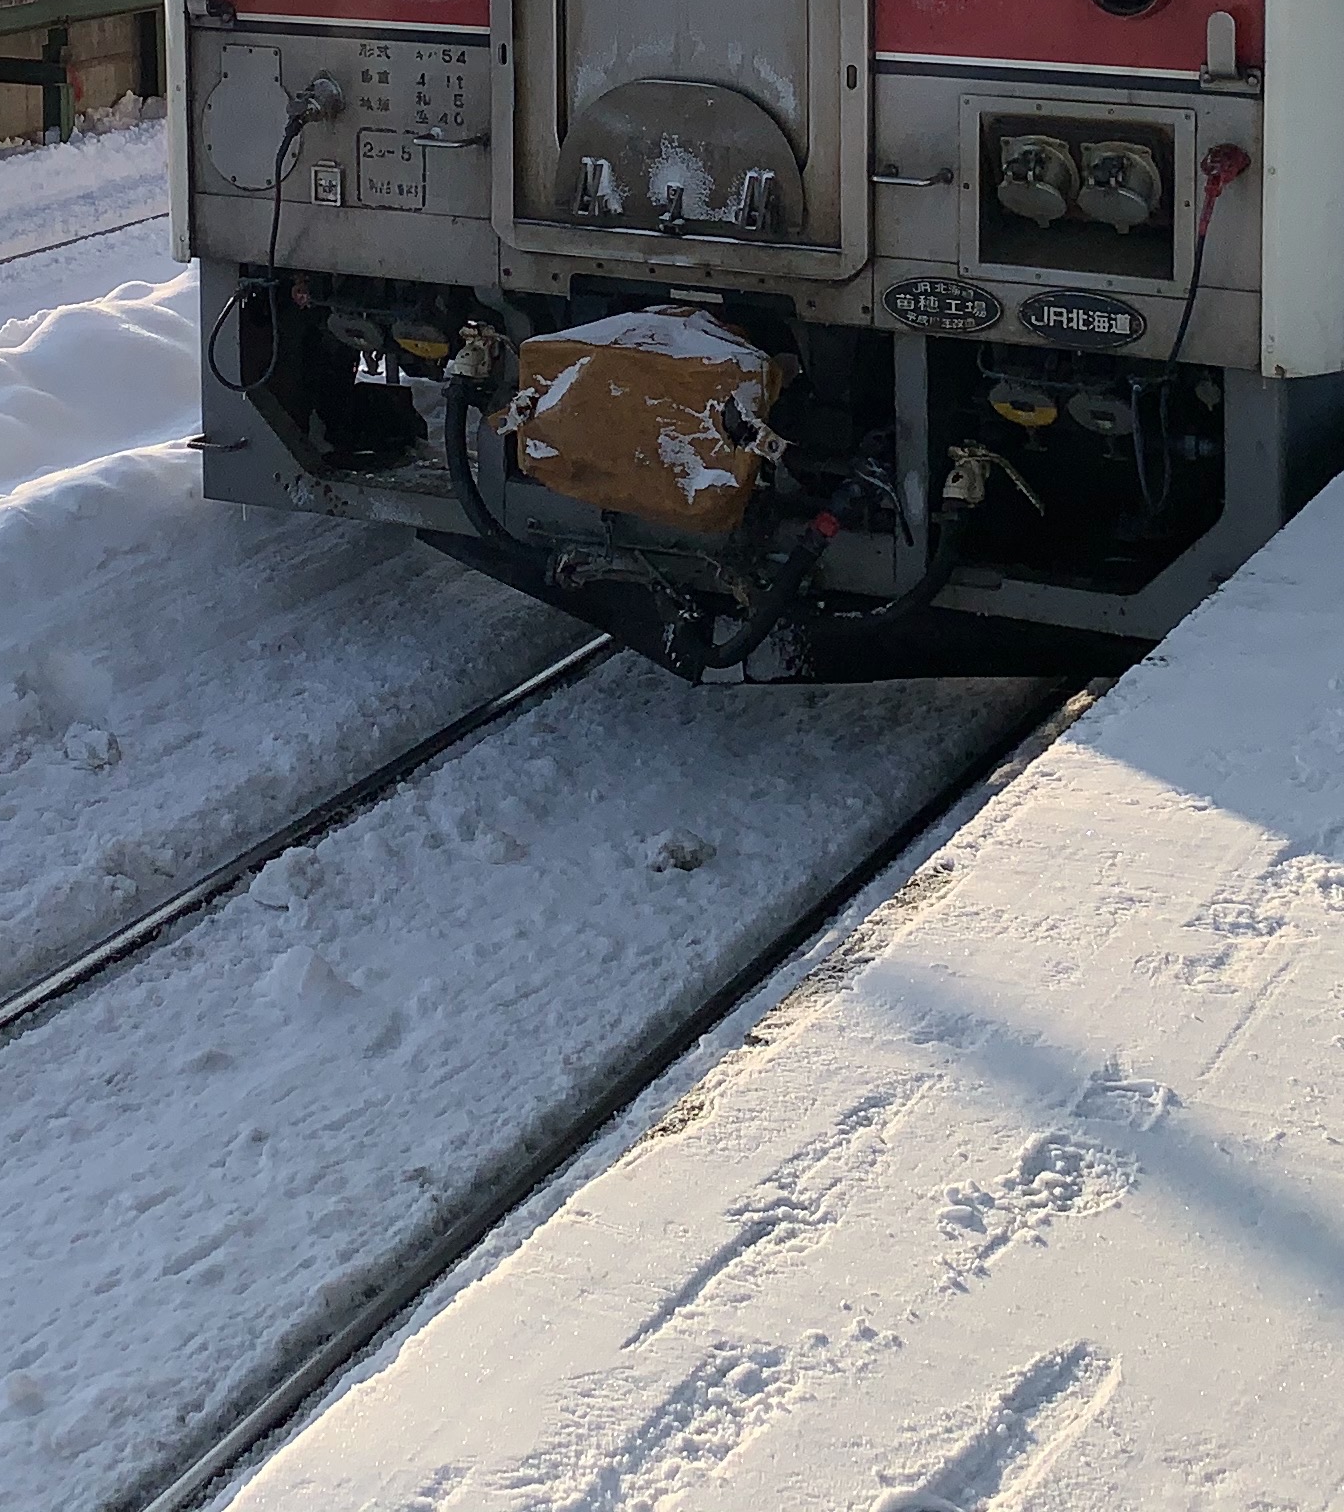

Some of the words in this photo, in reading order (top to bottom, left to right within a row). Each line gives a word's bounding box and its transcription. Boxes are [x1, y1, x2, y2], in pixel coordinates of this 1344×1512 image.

[895, 292, 987, 318] 苗穂工場
[1031, 306, 1131, 335] JR北海道
